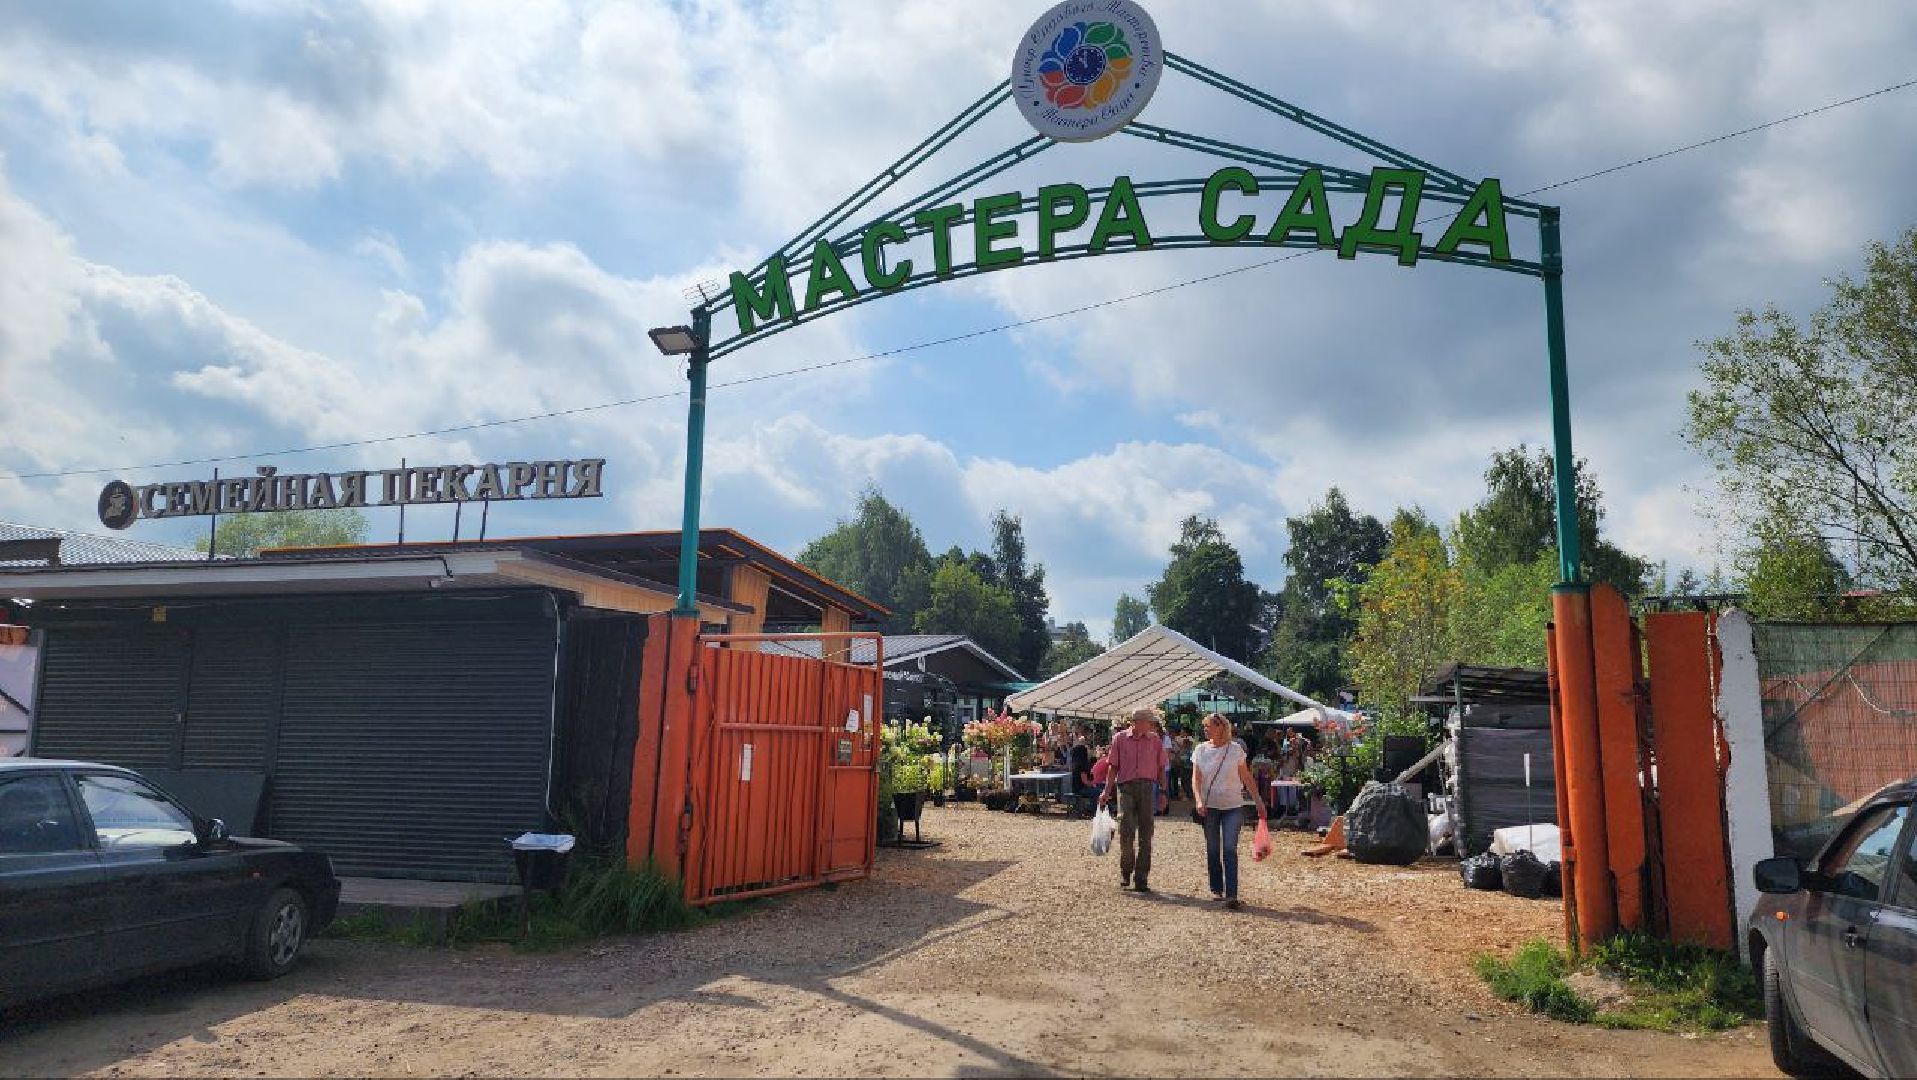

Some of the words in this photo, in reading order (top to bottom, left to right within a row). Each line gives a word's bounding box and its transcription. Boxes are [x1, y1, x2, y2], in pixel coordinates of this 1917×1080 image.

[728, 175, 1153, 335] МАСТЕРА
[1199, 166, 1512, 267] САДА
[138, 466, 367, 519] СЕМЕЙНАЯ
[381, 458, 605, 505] ПЕКАРНЯ
